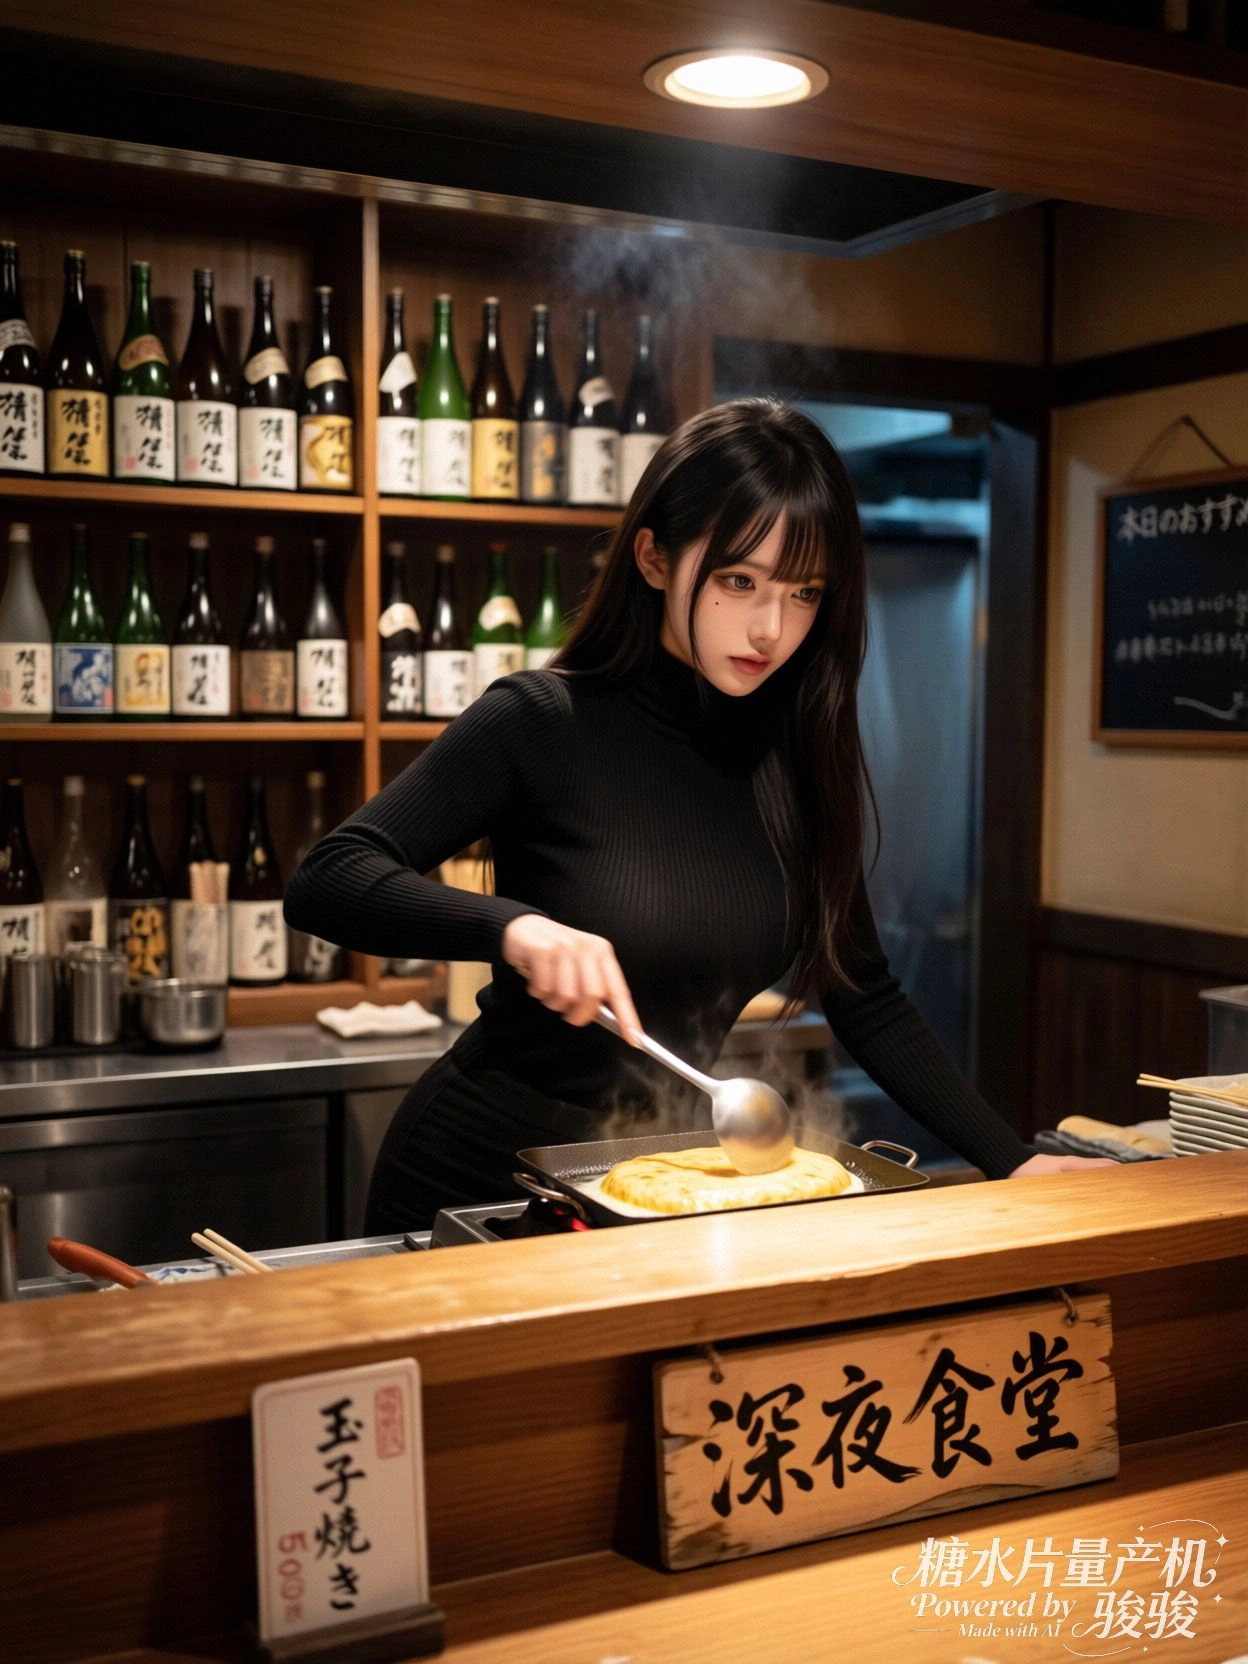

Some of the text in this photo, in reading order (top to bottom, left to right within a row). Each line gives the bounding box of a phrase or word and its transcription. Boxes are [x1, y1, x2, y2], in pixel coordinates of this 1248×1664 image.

[314, 1397, 371, 1610] 玉子焼き
[703, 1331, 1084, 1517] 深夜食堂
